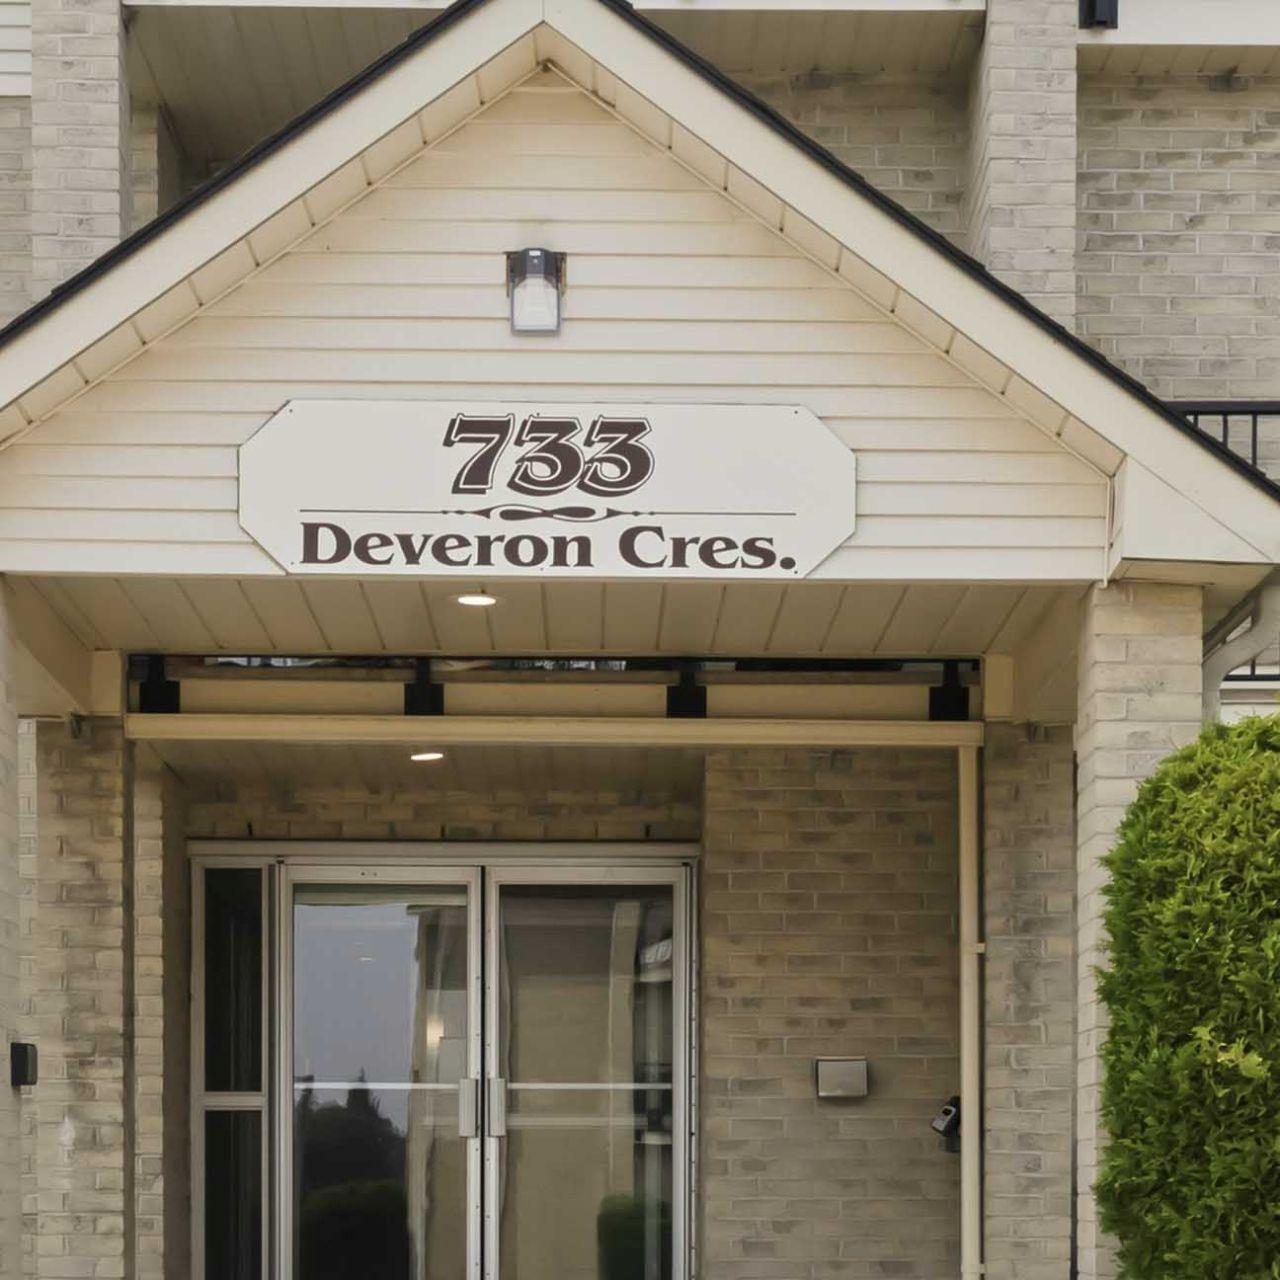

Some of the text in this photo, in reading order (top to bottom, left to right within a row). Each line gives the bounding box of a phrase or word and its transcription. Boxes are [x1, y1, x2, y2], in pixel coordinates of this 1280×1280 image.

[442, 412, 655, 497] 733
[299, 521, 797, 570] Deveron Cres.
